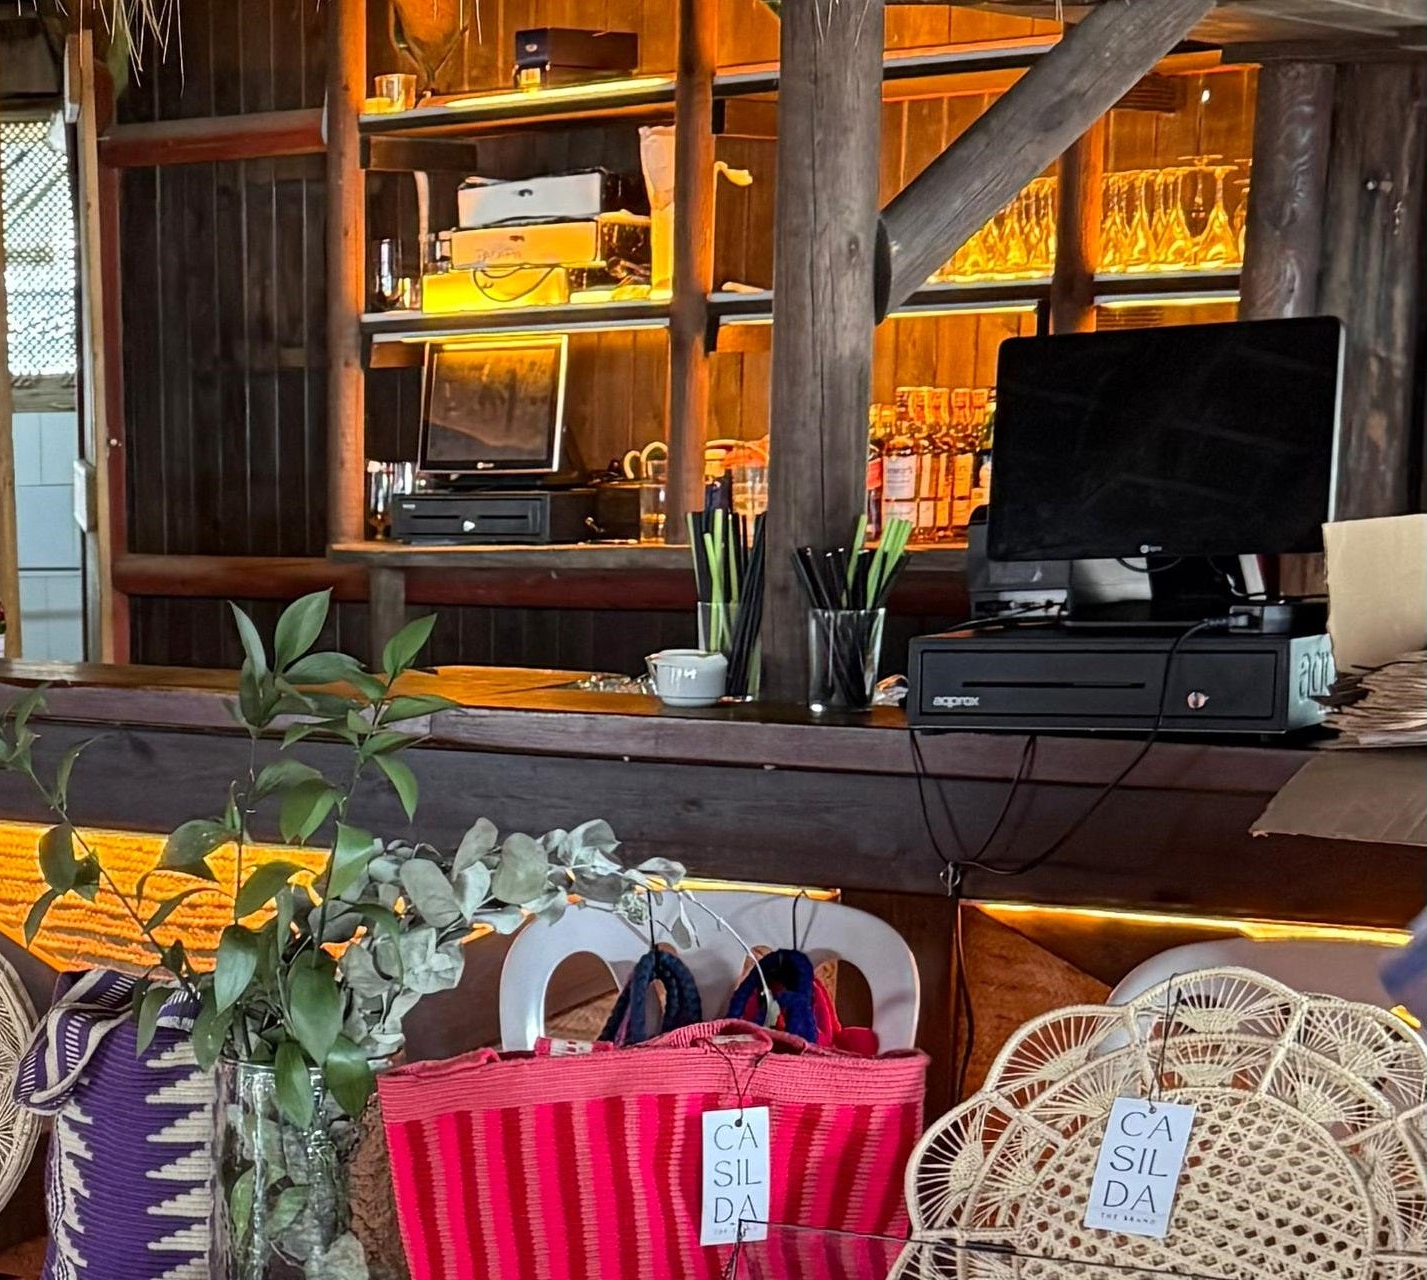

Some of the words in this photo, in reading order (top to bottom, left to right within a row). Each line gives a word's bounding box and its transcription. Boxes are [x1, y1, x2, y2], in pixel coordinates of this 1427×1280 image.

[714, 1122, 758, 1150] CA
[1120, 1111, 1172, 1142] CA
[713, 1158, 762, 1187] SIL
[1109, 1144, 1168, 1177] SIL
[714, 1194, 757, 1223] DA
[1102, 1179, 1156, 1213] DA
